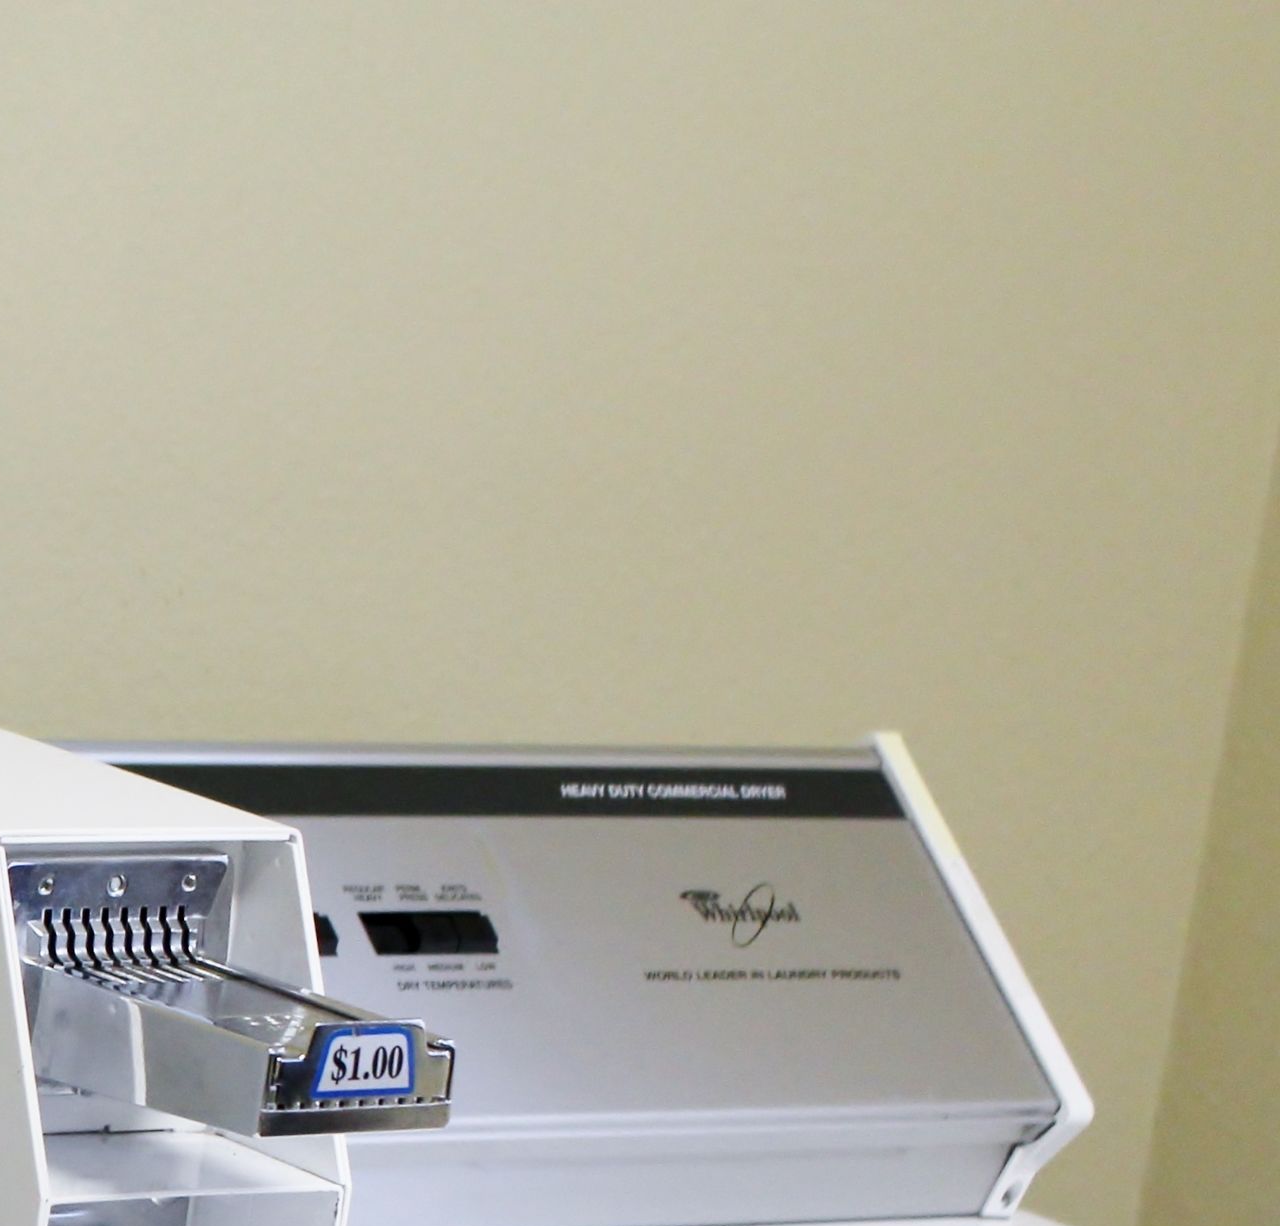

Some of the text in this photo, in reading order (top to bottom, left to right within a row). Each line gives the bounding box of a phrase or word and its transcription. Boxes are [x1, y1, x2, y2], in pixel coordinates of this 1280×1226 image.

[560, 783, 787, 800] HEAVY DUTY COMMERCIAL DRYER
[644, 968, 901, 982] WORLD LEADER IN LAUNDRY PRODUCTS
[329, 1044, 404, 1086] $1.00
